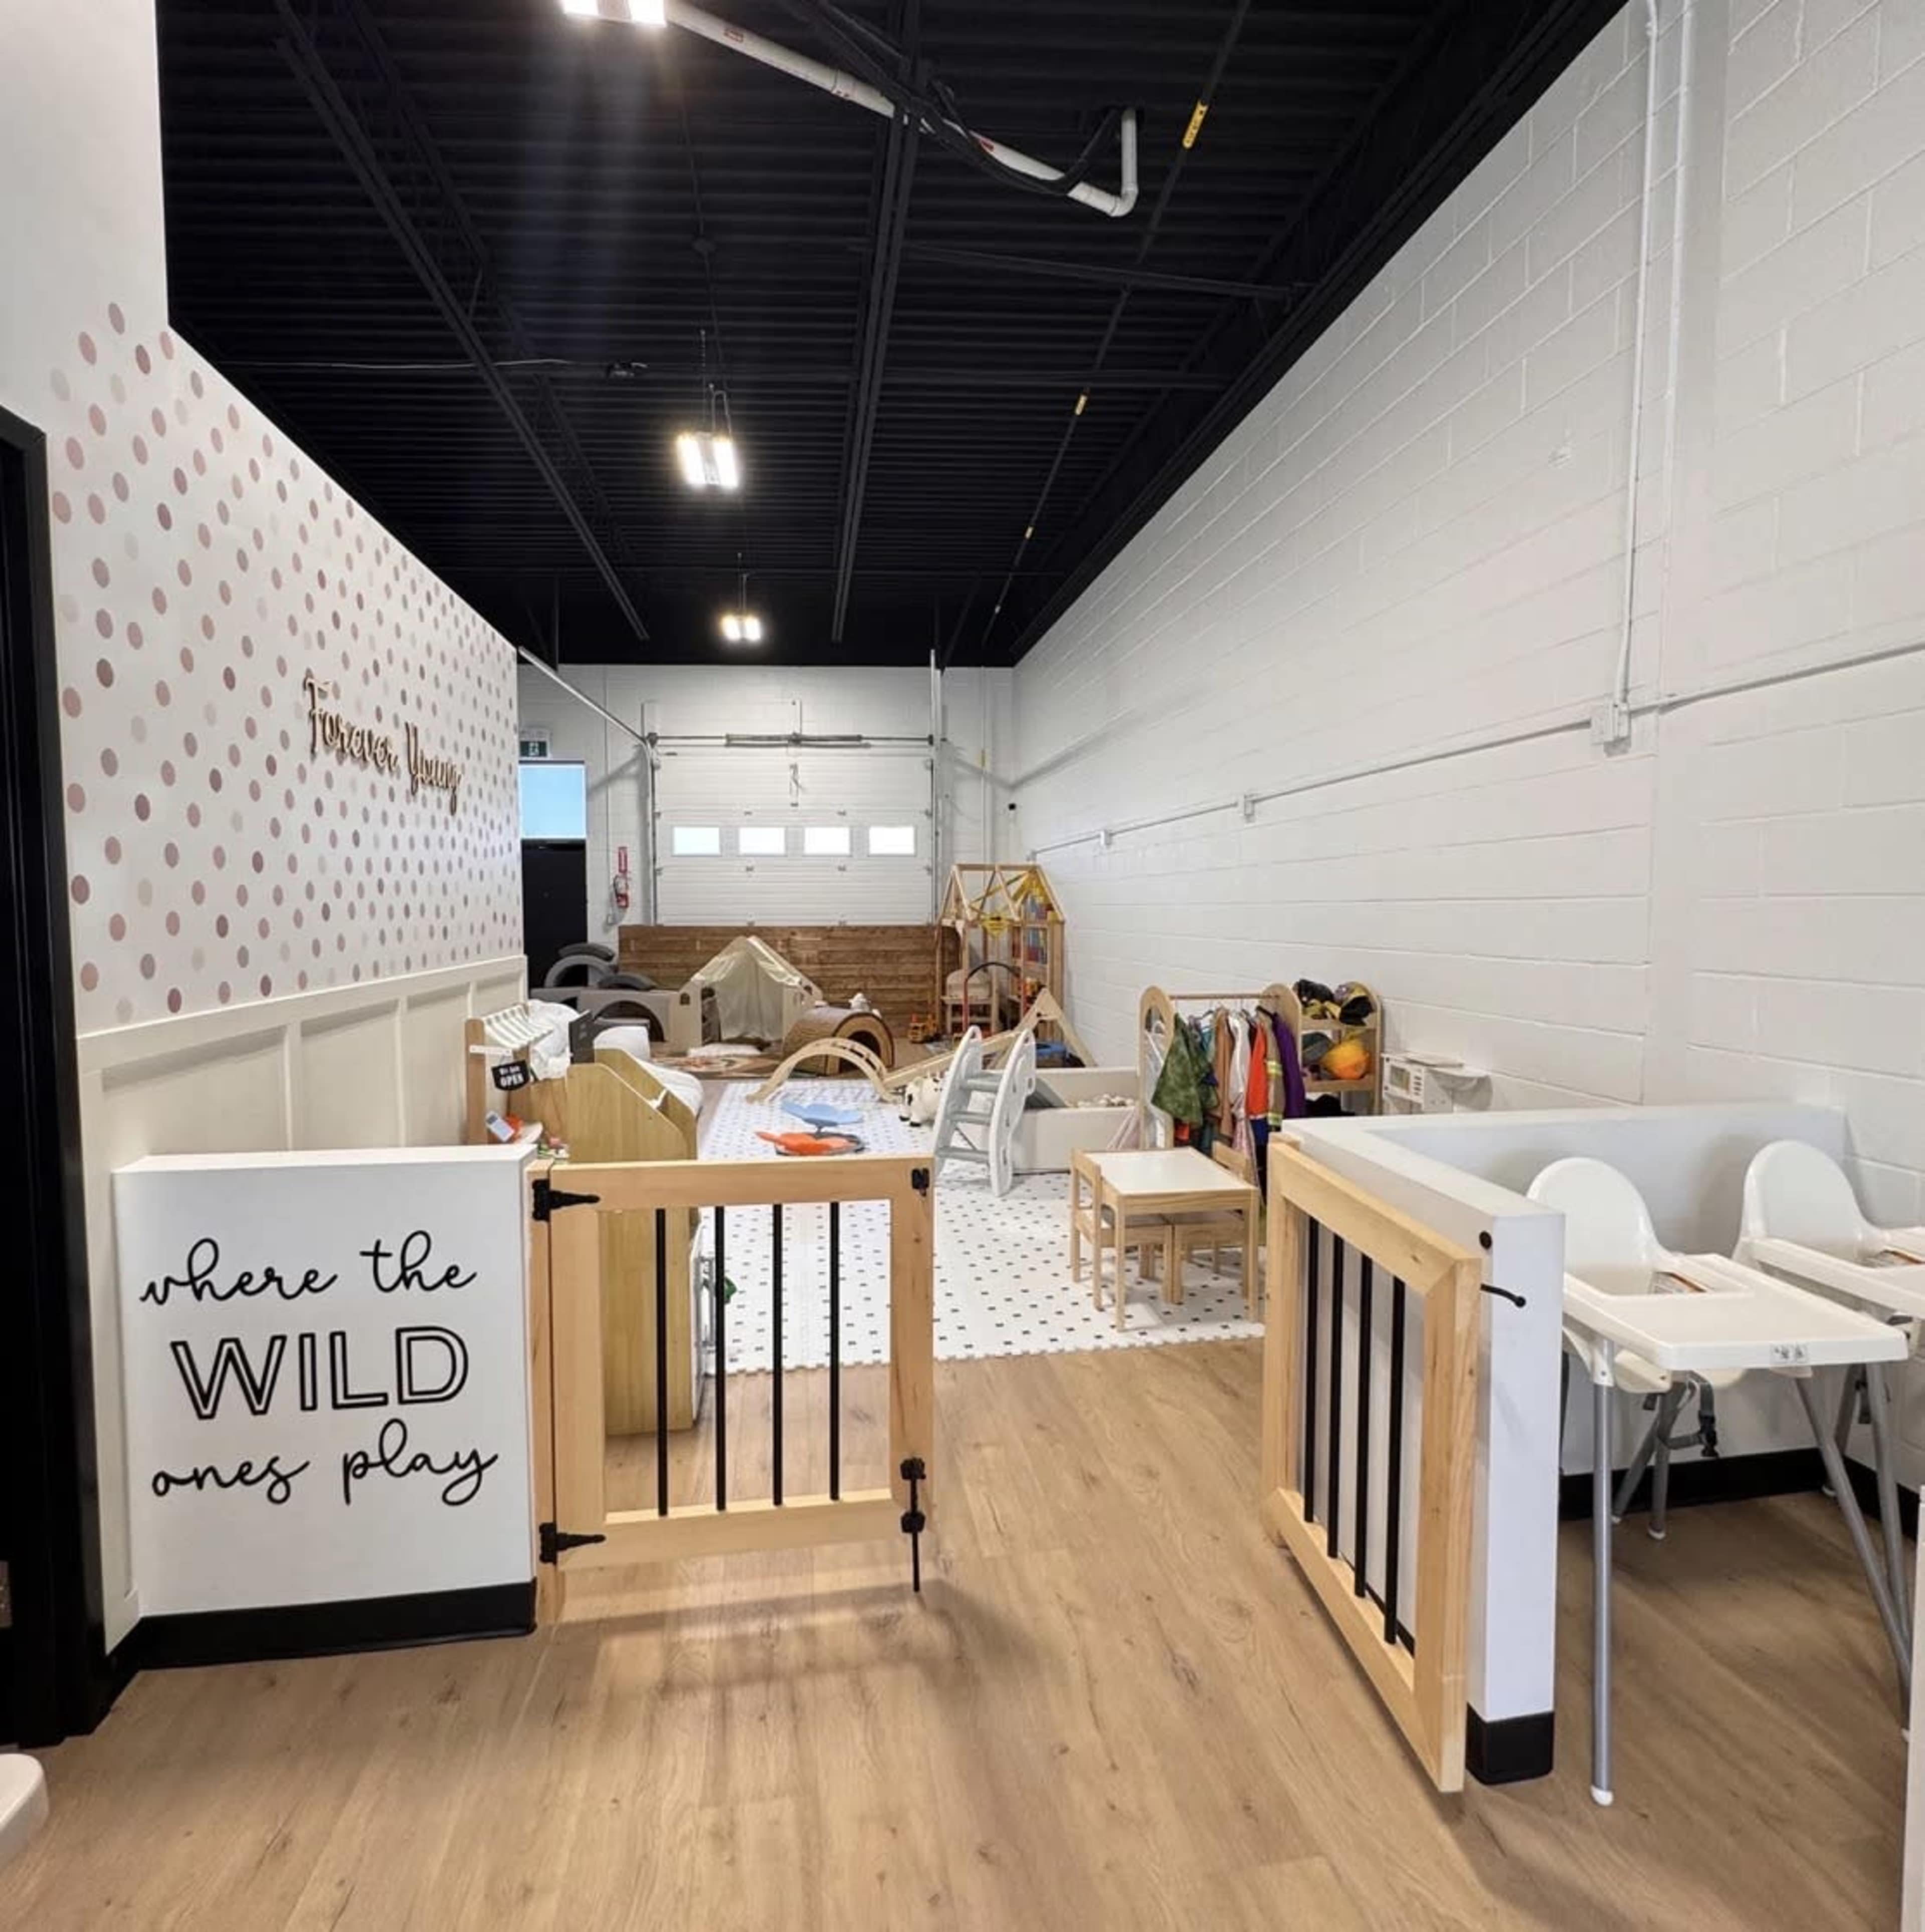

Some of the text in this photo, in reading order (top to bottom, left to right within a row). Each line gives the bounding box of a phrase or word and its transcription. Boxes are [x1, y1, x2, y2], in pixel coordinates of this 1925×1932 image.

[303, 677, 462, 816] Forever Young
[500, 1073, 524, 1087] OPEN
[140, 1230, 477, 1305] where the
[170, 1326, 469, 1420] WILD
[152, 1418, 498, 1506] ones play
